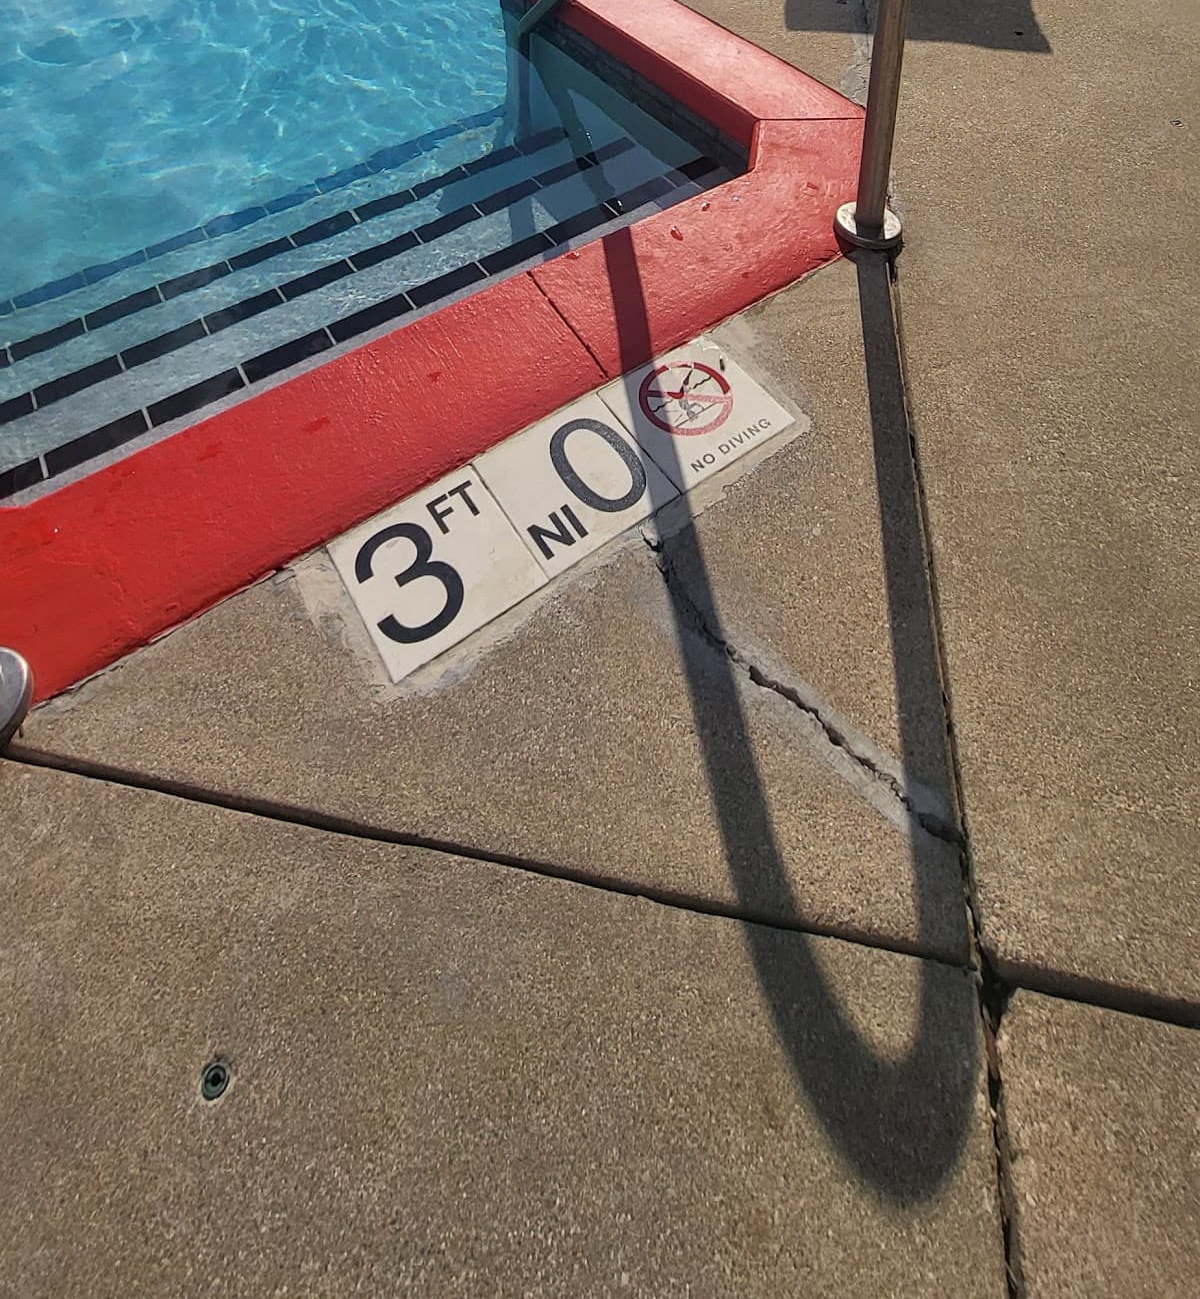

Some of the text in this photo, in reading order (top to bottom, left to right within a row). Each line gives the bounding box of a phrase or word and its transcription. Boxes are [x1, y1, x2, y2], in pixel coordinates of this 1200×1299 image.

[690, 418, 772, 473] NO DIVING
[355, 480, 480, 644] 3 FT
